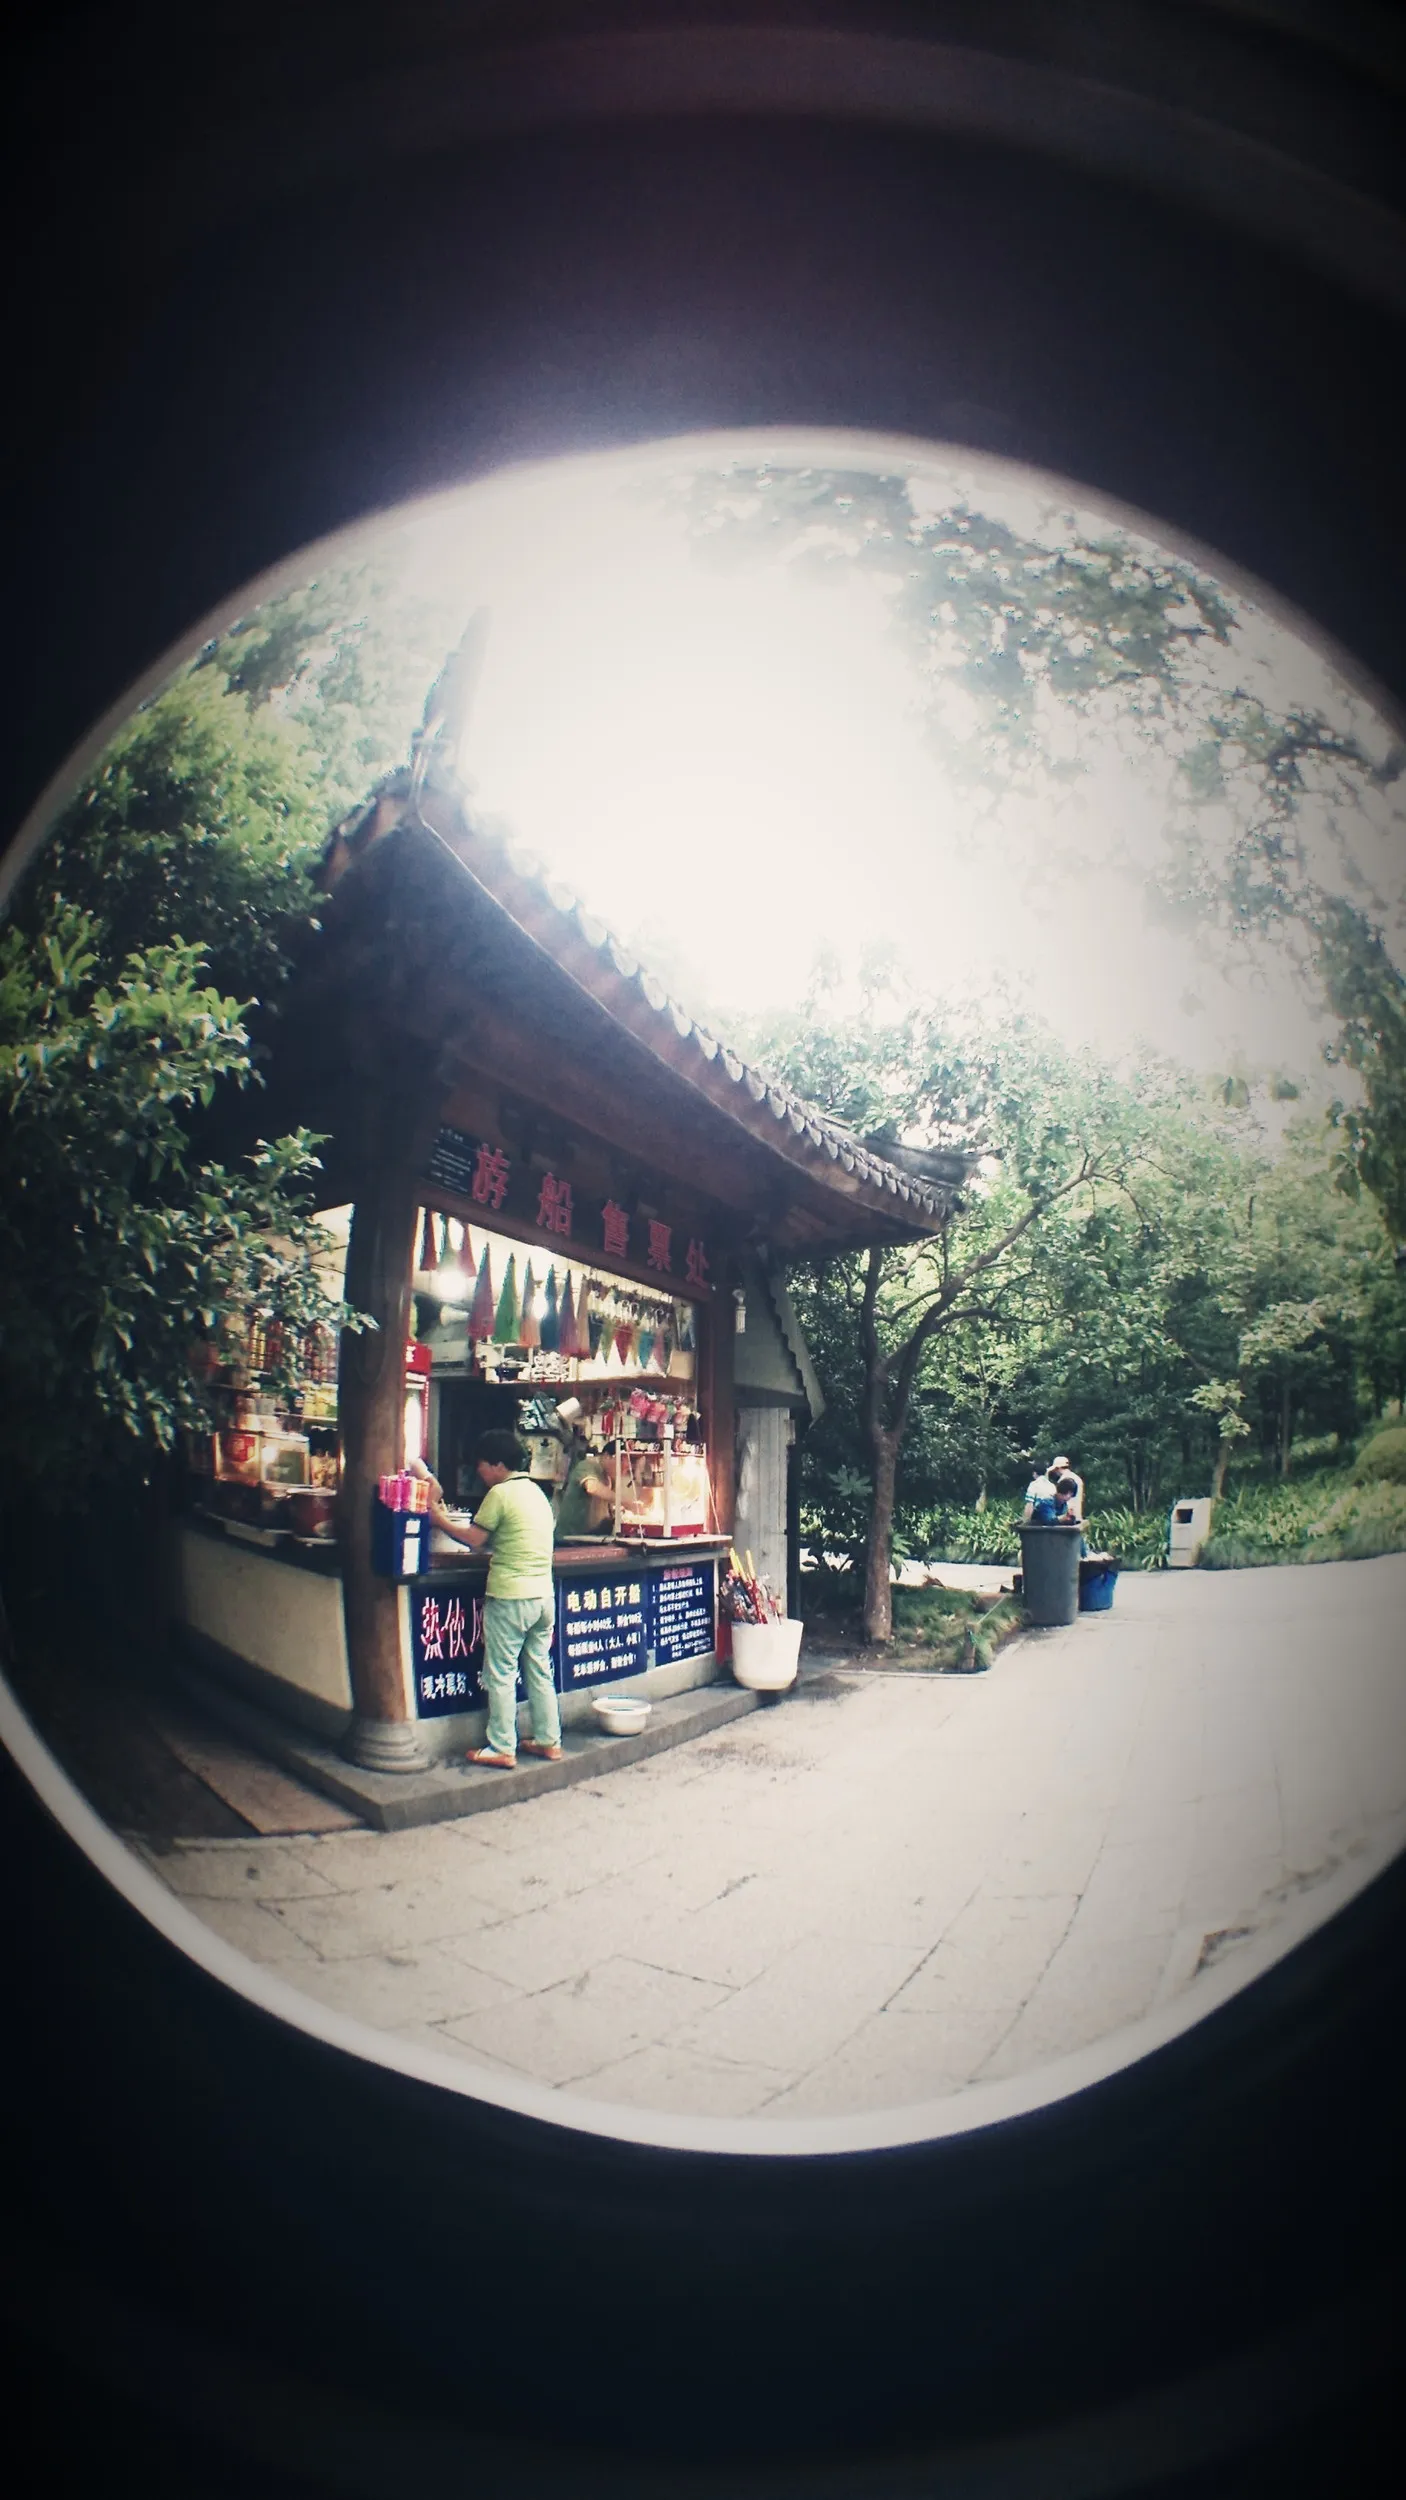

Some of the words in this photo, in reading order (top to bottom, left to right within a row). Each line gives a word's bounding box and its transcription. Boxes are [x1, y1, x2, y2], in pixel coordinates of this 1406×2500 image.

[567, 1584, 641, 1612] 电动自开船
